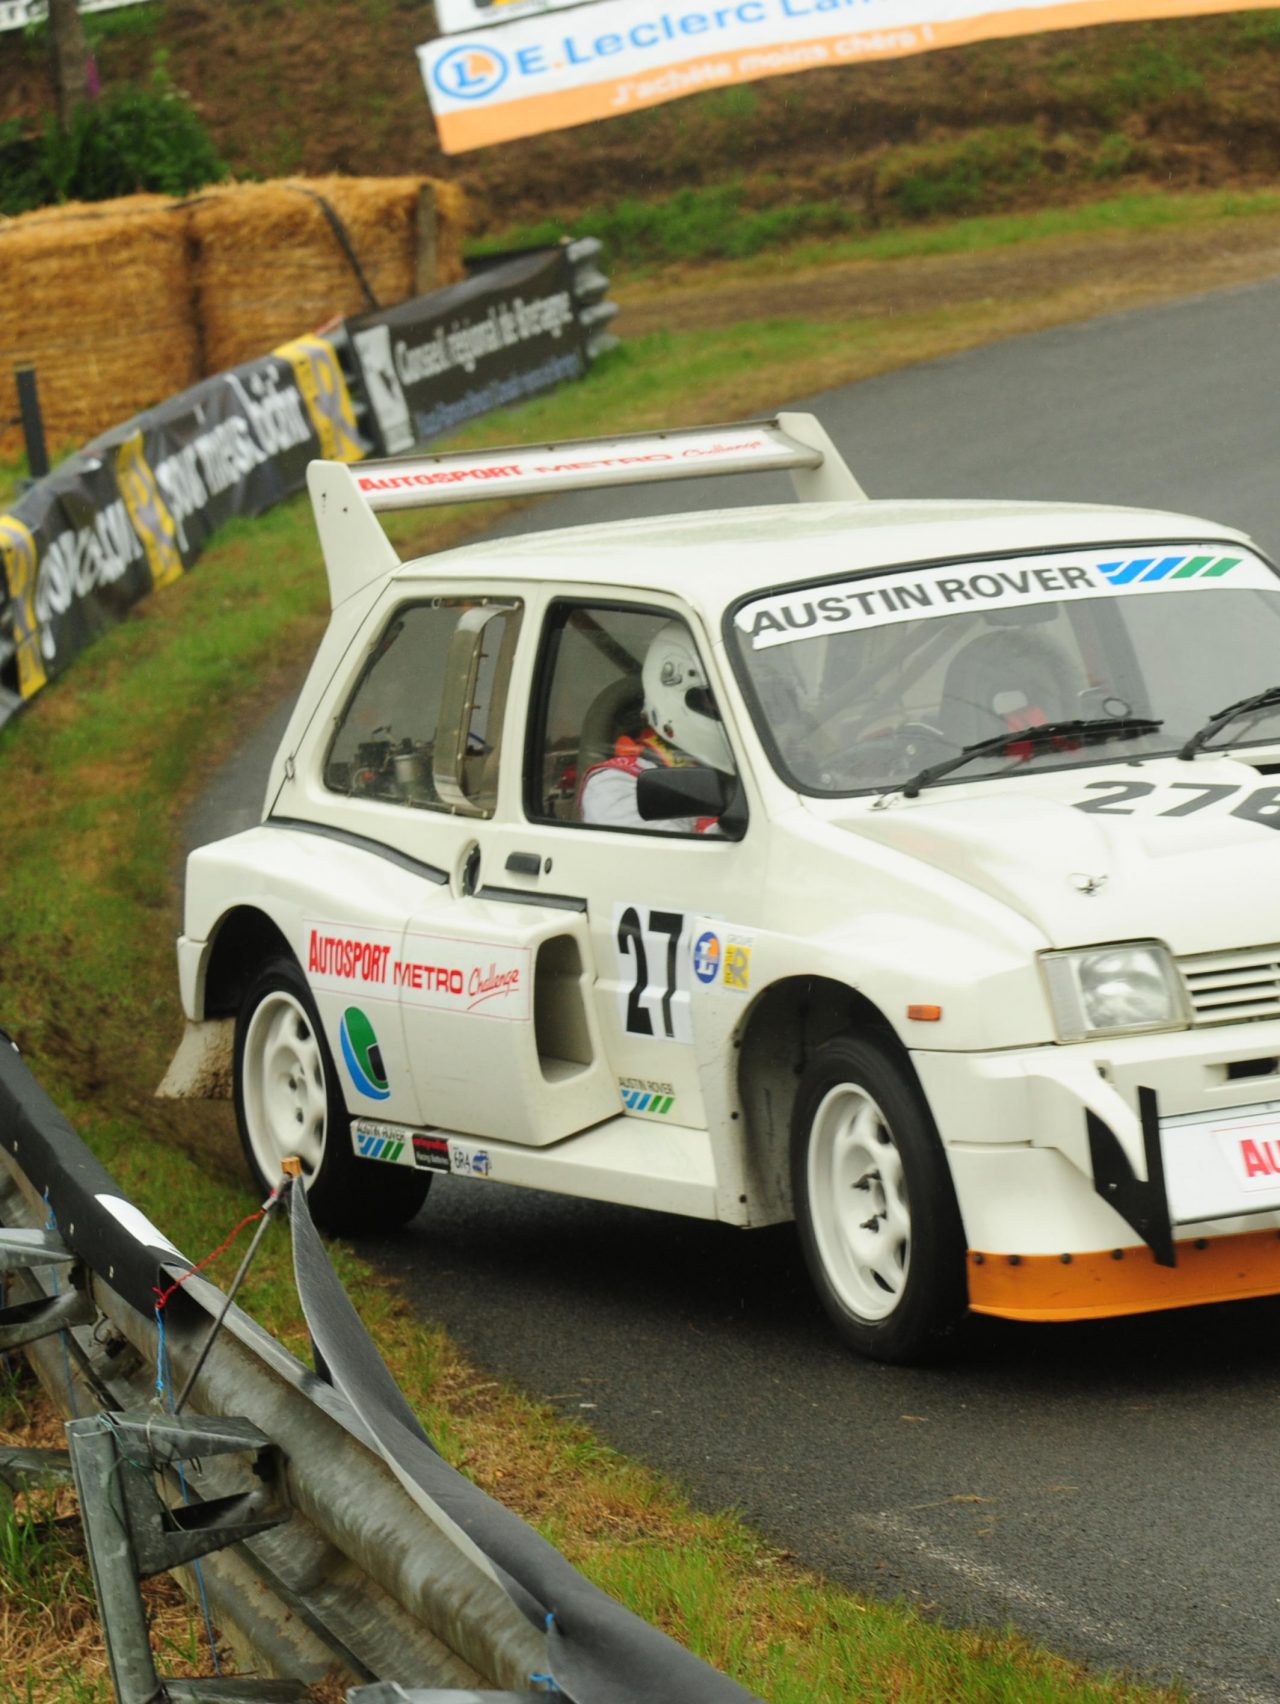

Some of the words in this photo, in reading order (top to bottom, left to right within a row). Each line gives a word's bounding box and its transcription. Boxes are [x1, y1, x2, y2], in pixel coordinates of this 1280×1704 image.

[359, 464, 523, 492] AUTOSPORT
[535, 453, 672, 473] METRO
[682, 438, 765, 458] Challenge
[751, 583, 931, 637] AUSTIN
[934, 565, 1097, 603] ROVER
[309, 930, 391, 984] AUTOSPORT
[394, 961, 463, 994] METRO
[467, 961, 520, 997] Challenge
[617, 907, 684, 1038] 27
[619, 1077, 646, 1092] AUSTIN
[647, 1081, 675, 1095] ROVER
